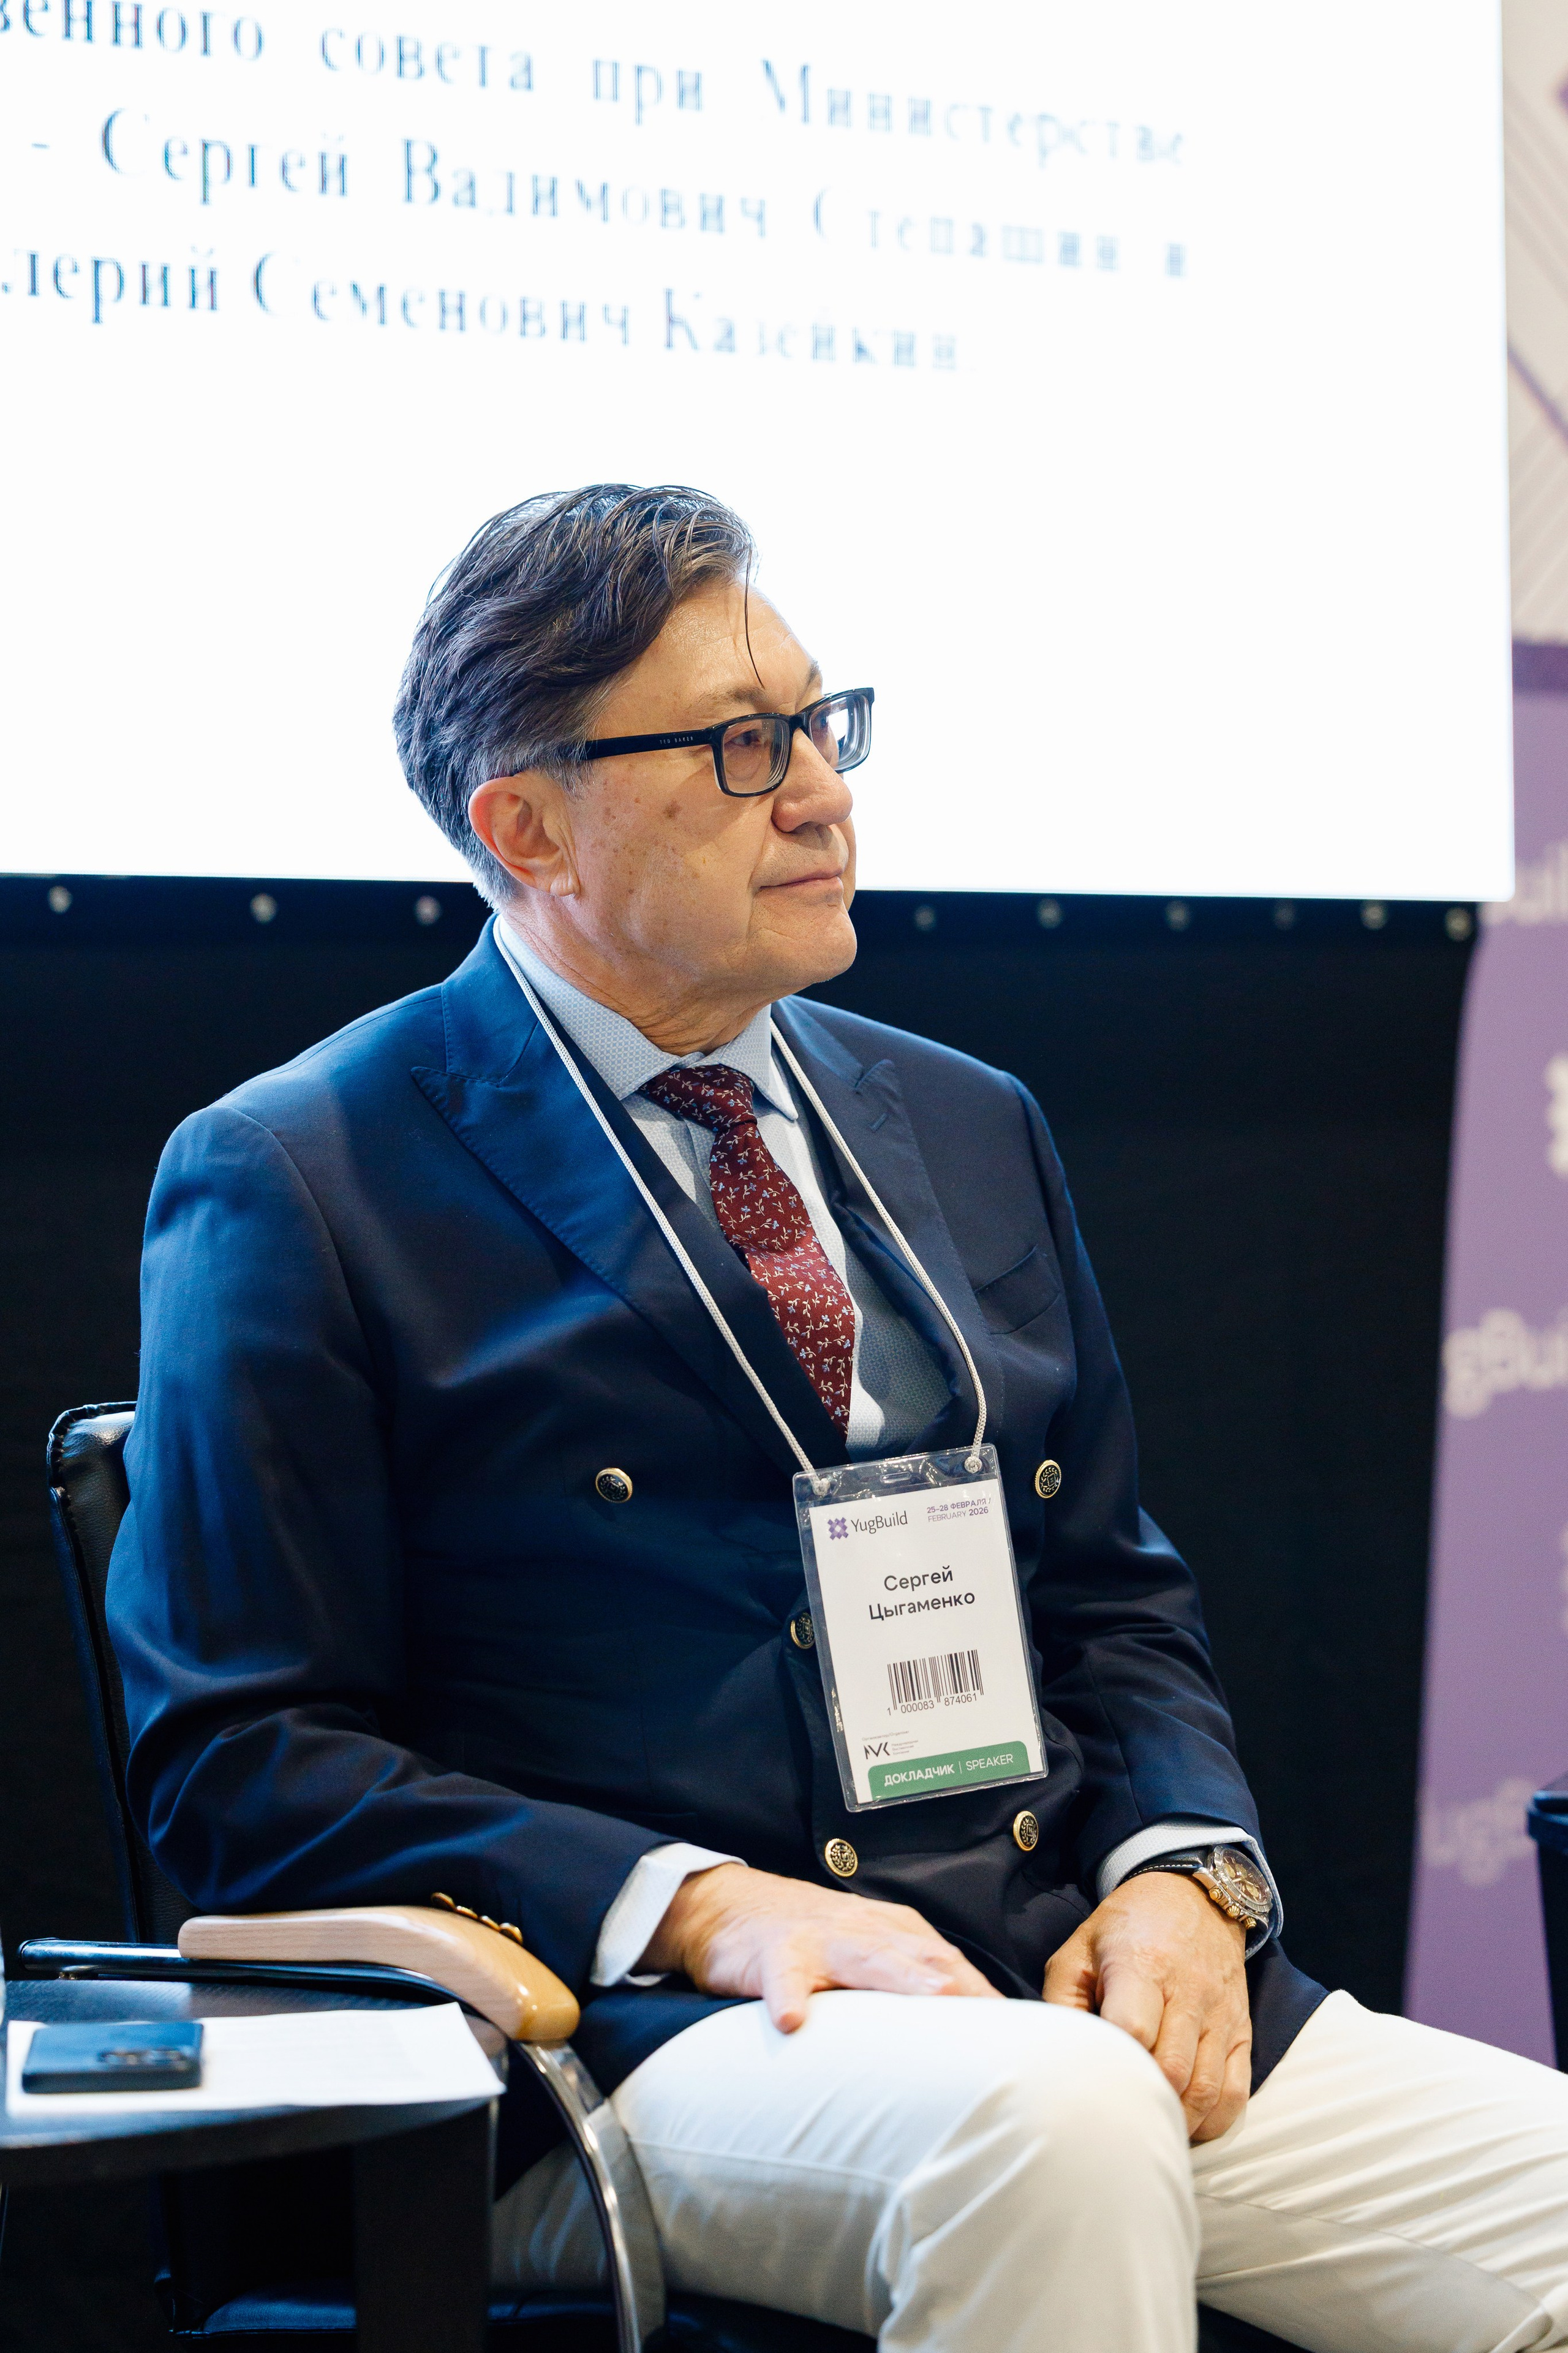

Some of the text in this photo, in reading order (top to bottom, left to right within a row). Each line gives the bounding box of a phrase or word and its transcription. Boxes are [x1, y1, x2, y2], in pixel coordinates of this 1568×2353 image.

[318, 27, 534, 93] совета
[592, 58, 703, 126] при
[98, 106, 349, 206] Сергей
[1, 245, 221, 325] лерий
[249, 250, 630, 348] Семенович
[928, 1506, 989, 1522] FEBRUARY 2026
[950, 1498, 987, 1509] ФЕВРАЛЯ
[851, 1510, 908, 1534] YugBuild
[884, 1565, 953, 1592] Сергей
[869, 1592, 975, 1621] Цыгаменко
[900, 1700, 935, 1714] 000083
[944, 1693, 977, 1706] 874061
[884, 1753, 1014, 1787] ДОКЛАДЧИК SPEAKER
